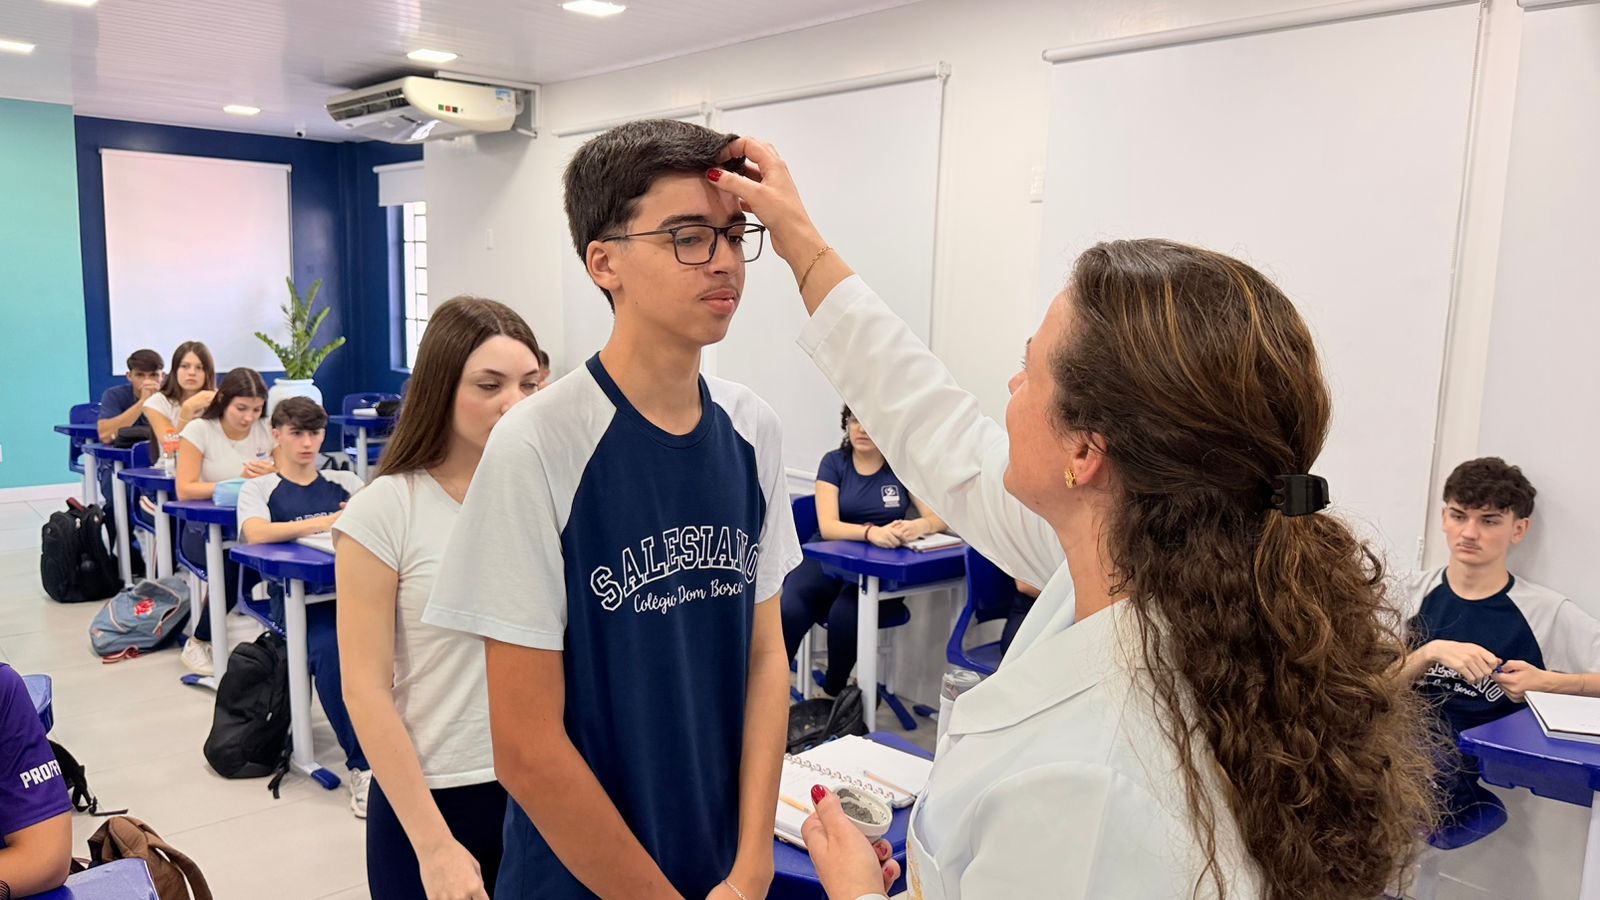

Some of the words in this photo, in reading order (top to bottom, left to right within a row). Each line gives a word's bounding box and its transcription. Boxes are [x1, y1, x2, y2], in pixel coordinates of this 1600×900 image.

[591, 526, 758, 611] SALESIANO
[634, 591, 676, 614] Colégio
[678, 585, 707, 604] Dom
[711, 578, 743, 597] Bosco
